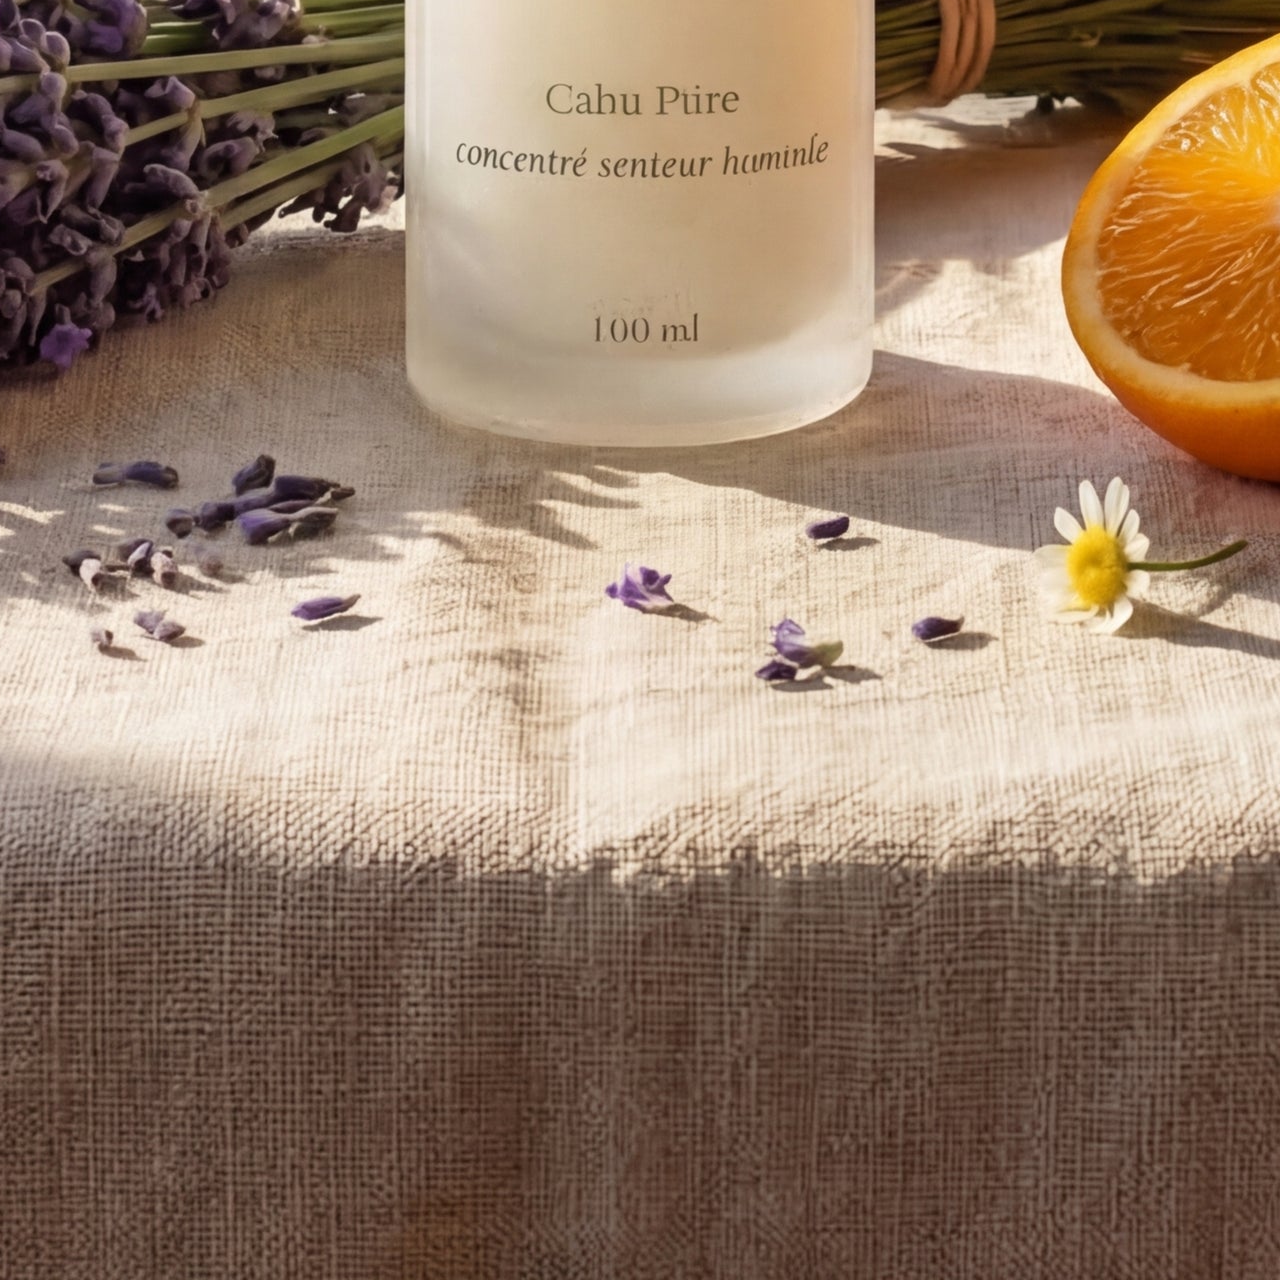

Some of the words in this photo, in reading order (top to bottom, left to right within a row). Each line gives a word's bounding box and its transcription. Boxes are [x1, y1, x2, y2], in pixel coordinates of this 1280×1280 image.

[456, 141, 588, 178] concentré
[597, 152, 713, 179] senteur
[594, 315, 651, 344] 100
[661, 313, 699, 344] ml
